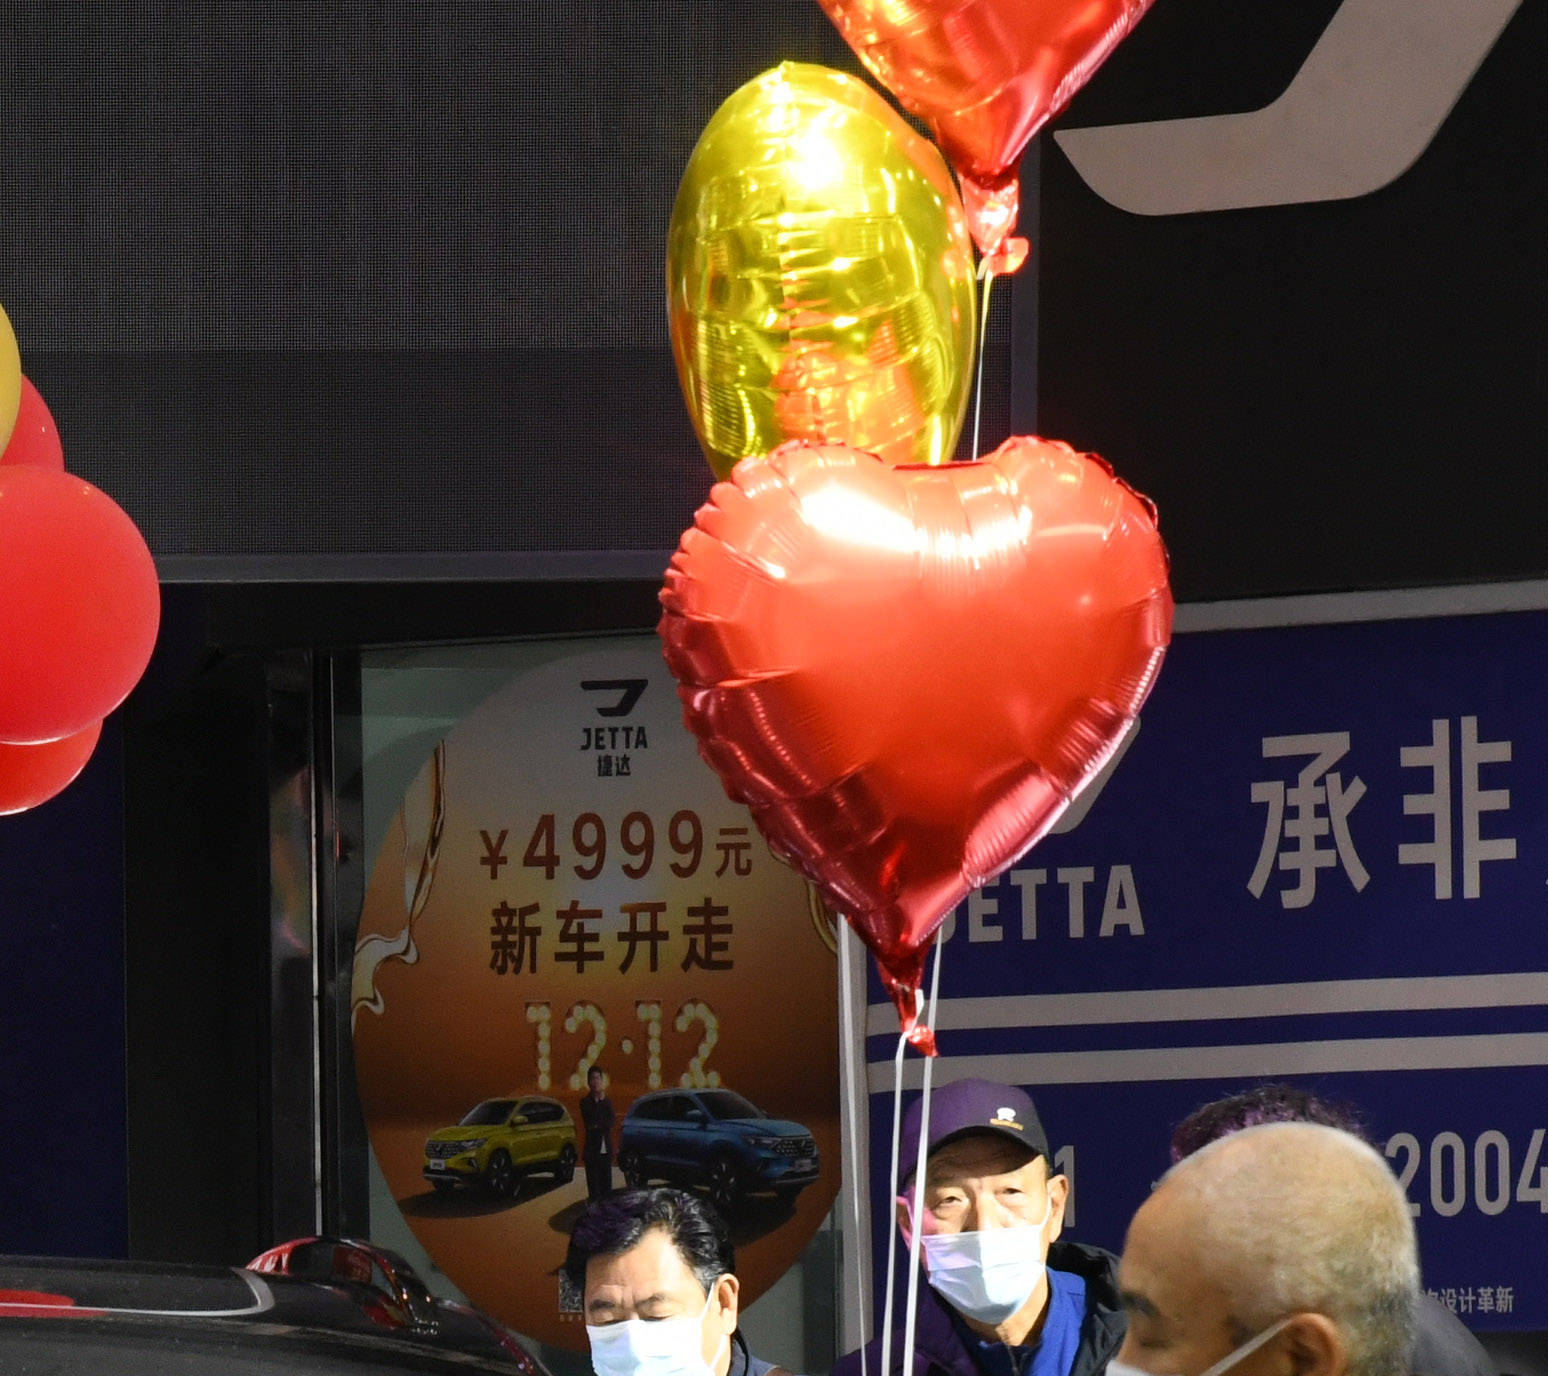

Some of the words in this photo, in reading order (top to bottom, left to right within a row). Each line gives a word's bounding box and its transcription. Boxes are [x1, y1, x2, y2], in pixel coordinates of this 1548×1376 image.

[581, 728, 648, 752] JETTA
[597, 755, 631, 778] 捷达
[488, 900, 735, 977] 新车开走
